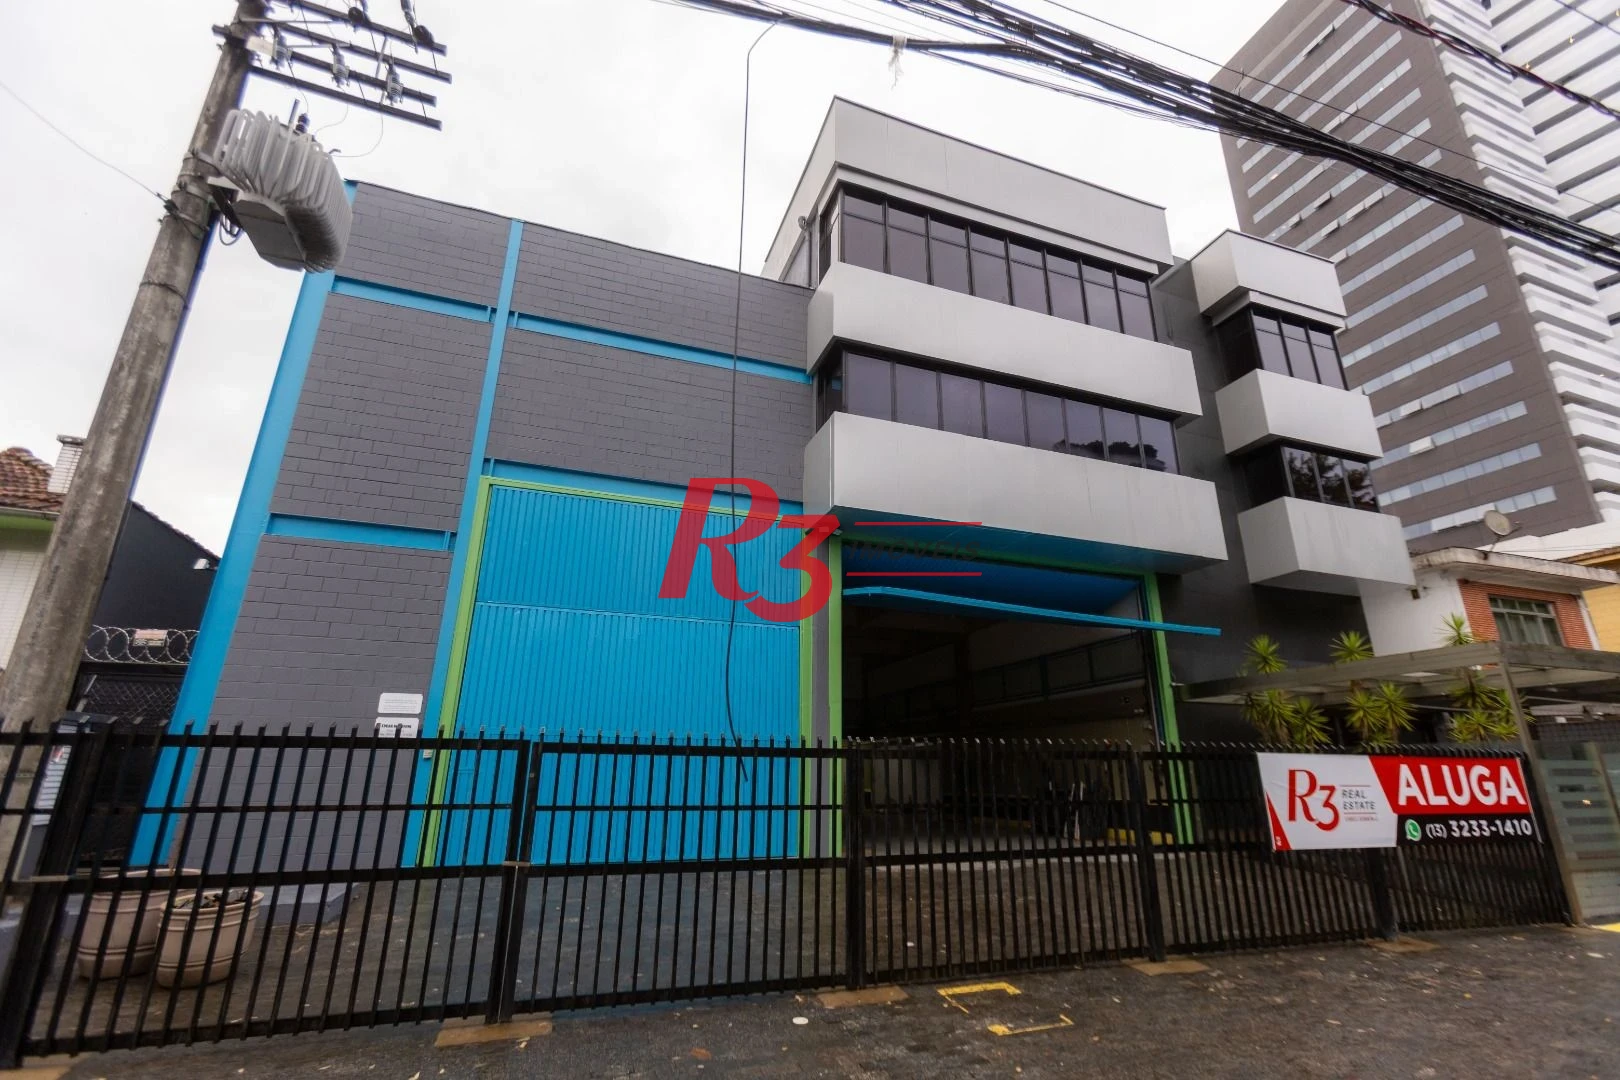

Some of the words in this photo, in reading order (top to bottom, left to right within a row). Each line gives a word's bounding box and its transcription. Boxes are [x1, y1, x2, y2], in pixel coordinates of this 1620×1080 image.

[1341, 788, 1367, 800] REAL
[1398, 763, 1528, 806] ALUGA
[1288, 769, 1340, 831] R3
[1343, 800, 1376, 811] ESTATE
[1425, 823, 1448, 839] (13)
[1448, 819, 1533, 837] 3233-1410
